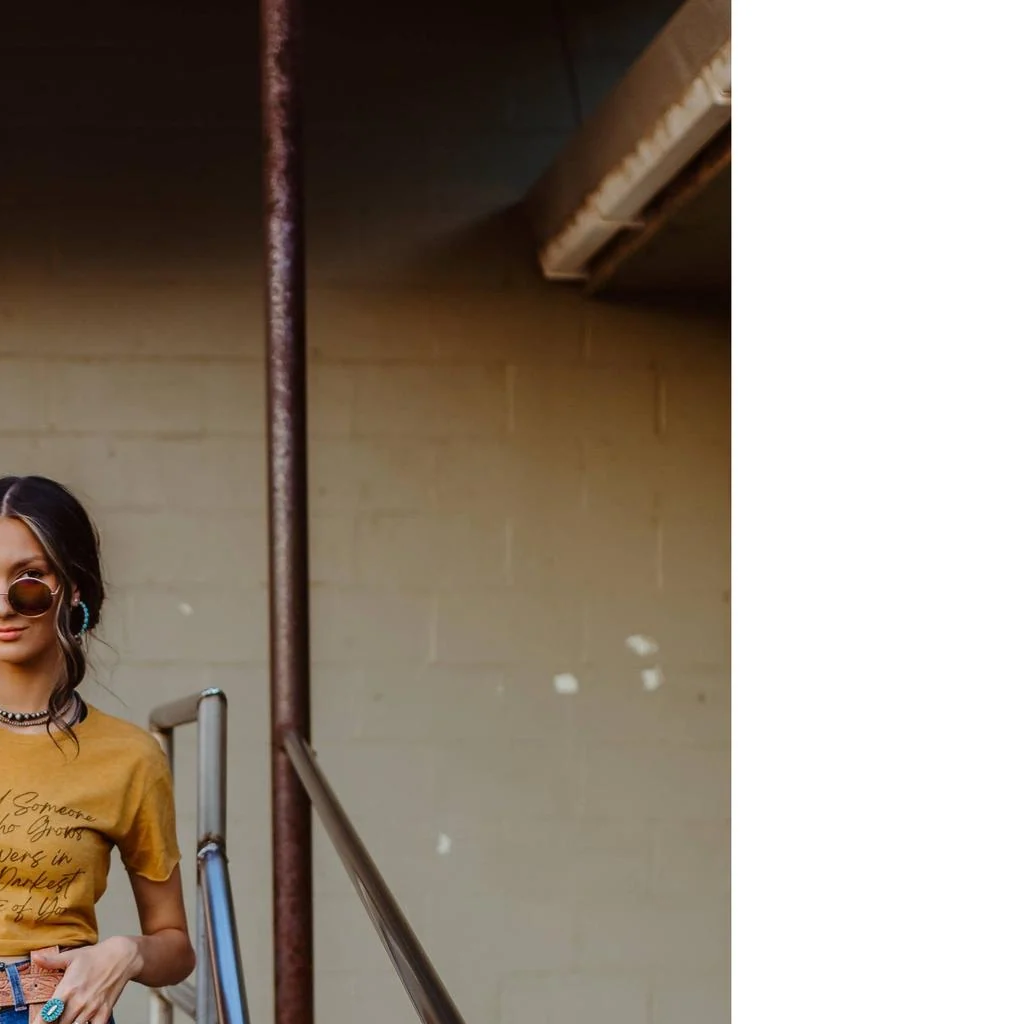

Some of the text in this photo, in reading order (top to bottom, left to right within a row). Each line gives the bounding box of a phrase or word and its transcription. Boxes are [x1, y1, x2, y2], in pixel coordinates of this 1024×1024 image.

[12, 791, 97, 823] Someone
[50, 848, 73, 866] in
[11, 895, 33, 923] of
